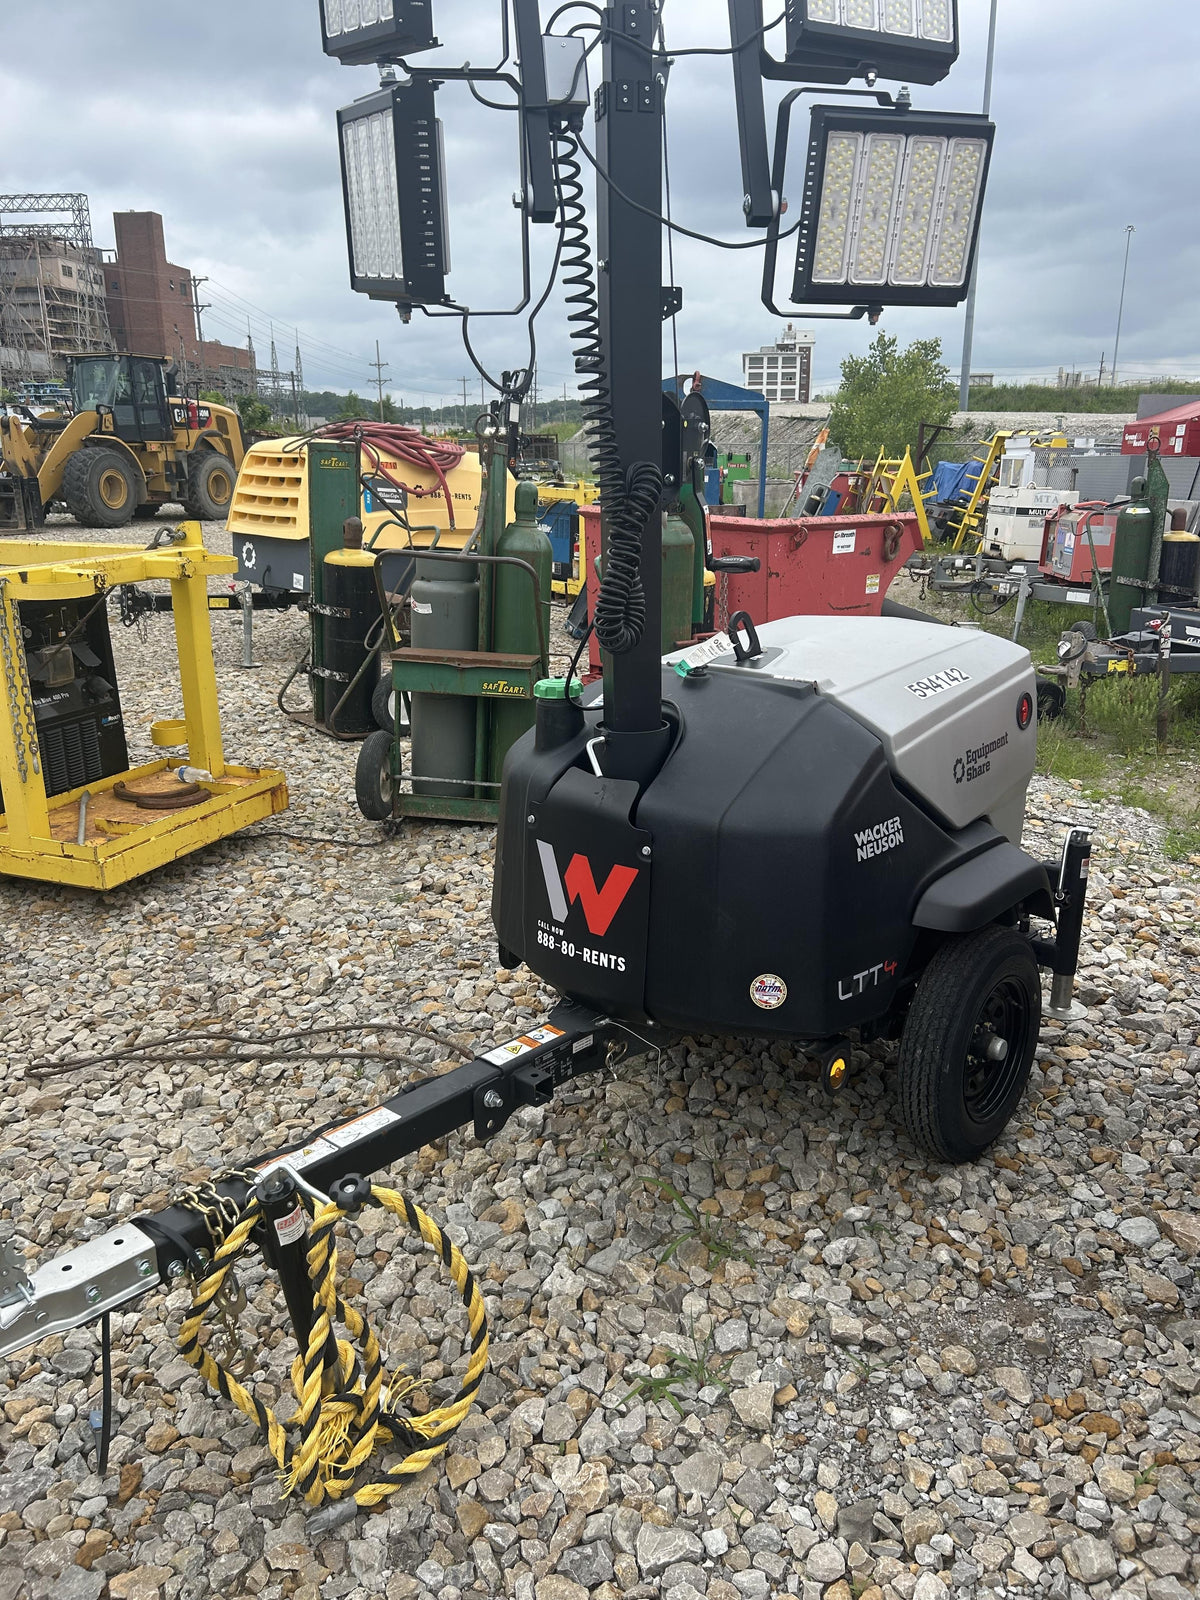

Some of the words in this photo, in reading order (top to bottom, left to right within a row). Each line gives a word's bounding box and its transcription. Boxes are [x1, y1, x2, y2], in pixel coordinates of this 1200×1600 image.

[1034, 495, 1059, 504] MTA
[907, 667, 970, 698] 594142
[965, 732, 1009, 765] Equipment
[966, 761, 991, 782] Share
[854, 816, 902, 846] WACKER
[856, 829, 904, 862] NEUSON
[537, 919, 550, 931] CALL
[551, 925, 564, 936] NOW
[537, 930, 626, 972] 888-80-RENTS
